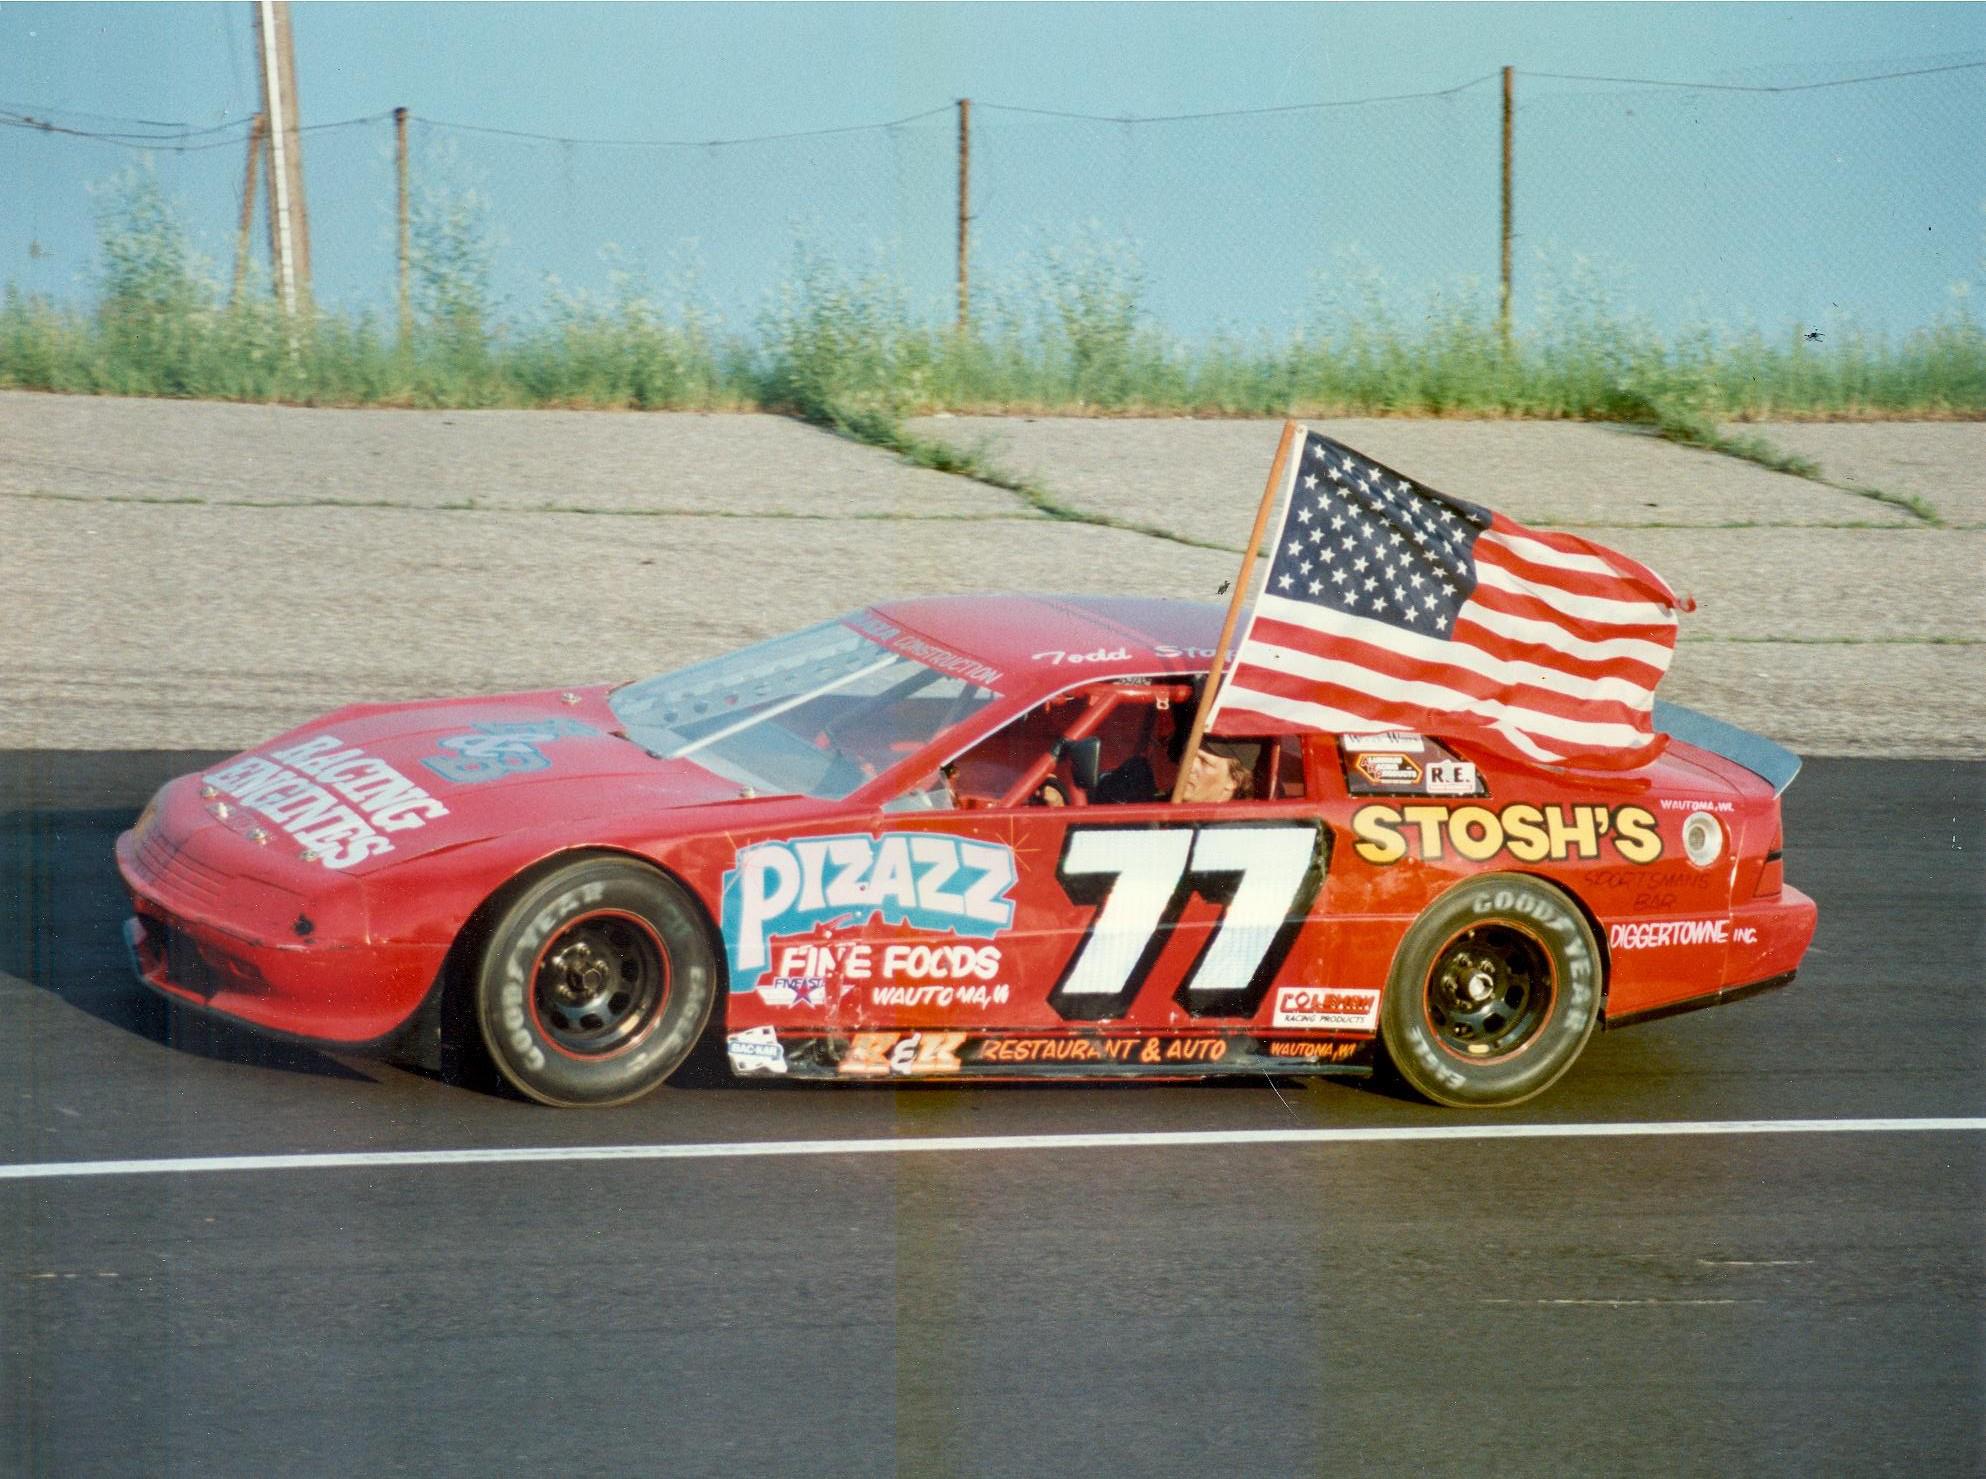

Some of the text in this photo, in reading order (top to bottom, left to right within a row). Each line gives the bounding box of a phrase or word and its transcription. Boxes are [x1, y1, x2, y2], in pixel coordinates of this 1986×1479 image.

[1031, 648, 1132, 665] Todd
[269, 735, 450, 832] RACING
[202, 757, 396, 869] ENGINES
[1352, 805, 1663, 865] STOSH'S
[1055, 822, 1326, 1008] 77
[1611, 919, 1730, 949] DIGGERTOWNE
[780, 945, 1002, 979] FINE FOODS
[1472, 890, 1592, 1032] GOODYEAR
[1320, 1014, 1366, 1023] PRODUCTS
[980, 1039, 1140, 1061] RESTAURANT
[1141, 1037, 1162, 1063] &
[1166, 1039, 1227, 1061] AUTO
